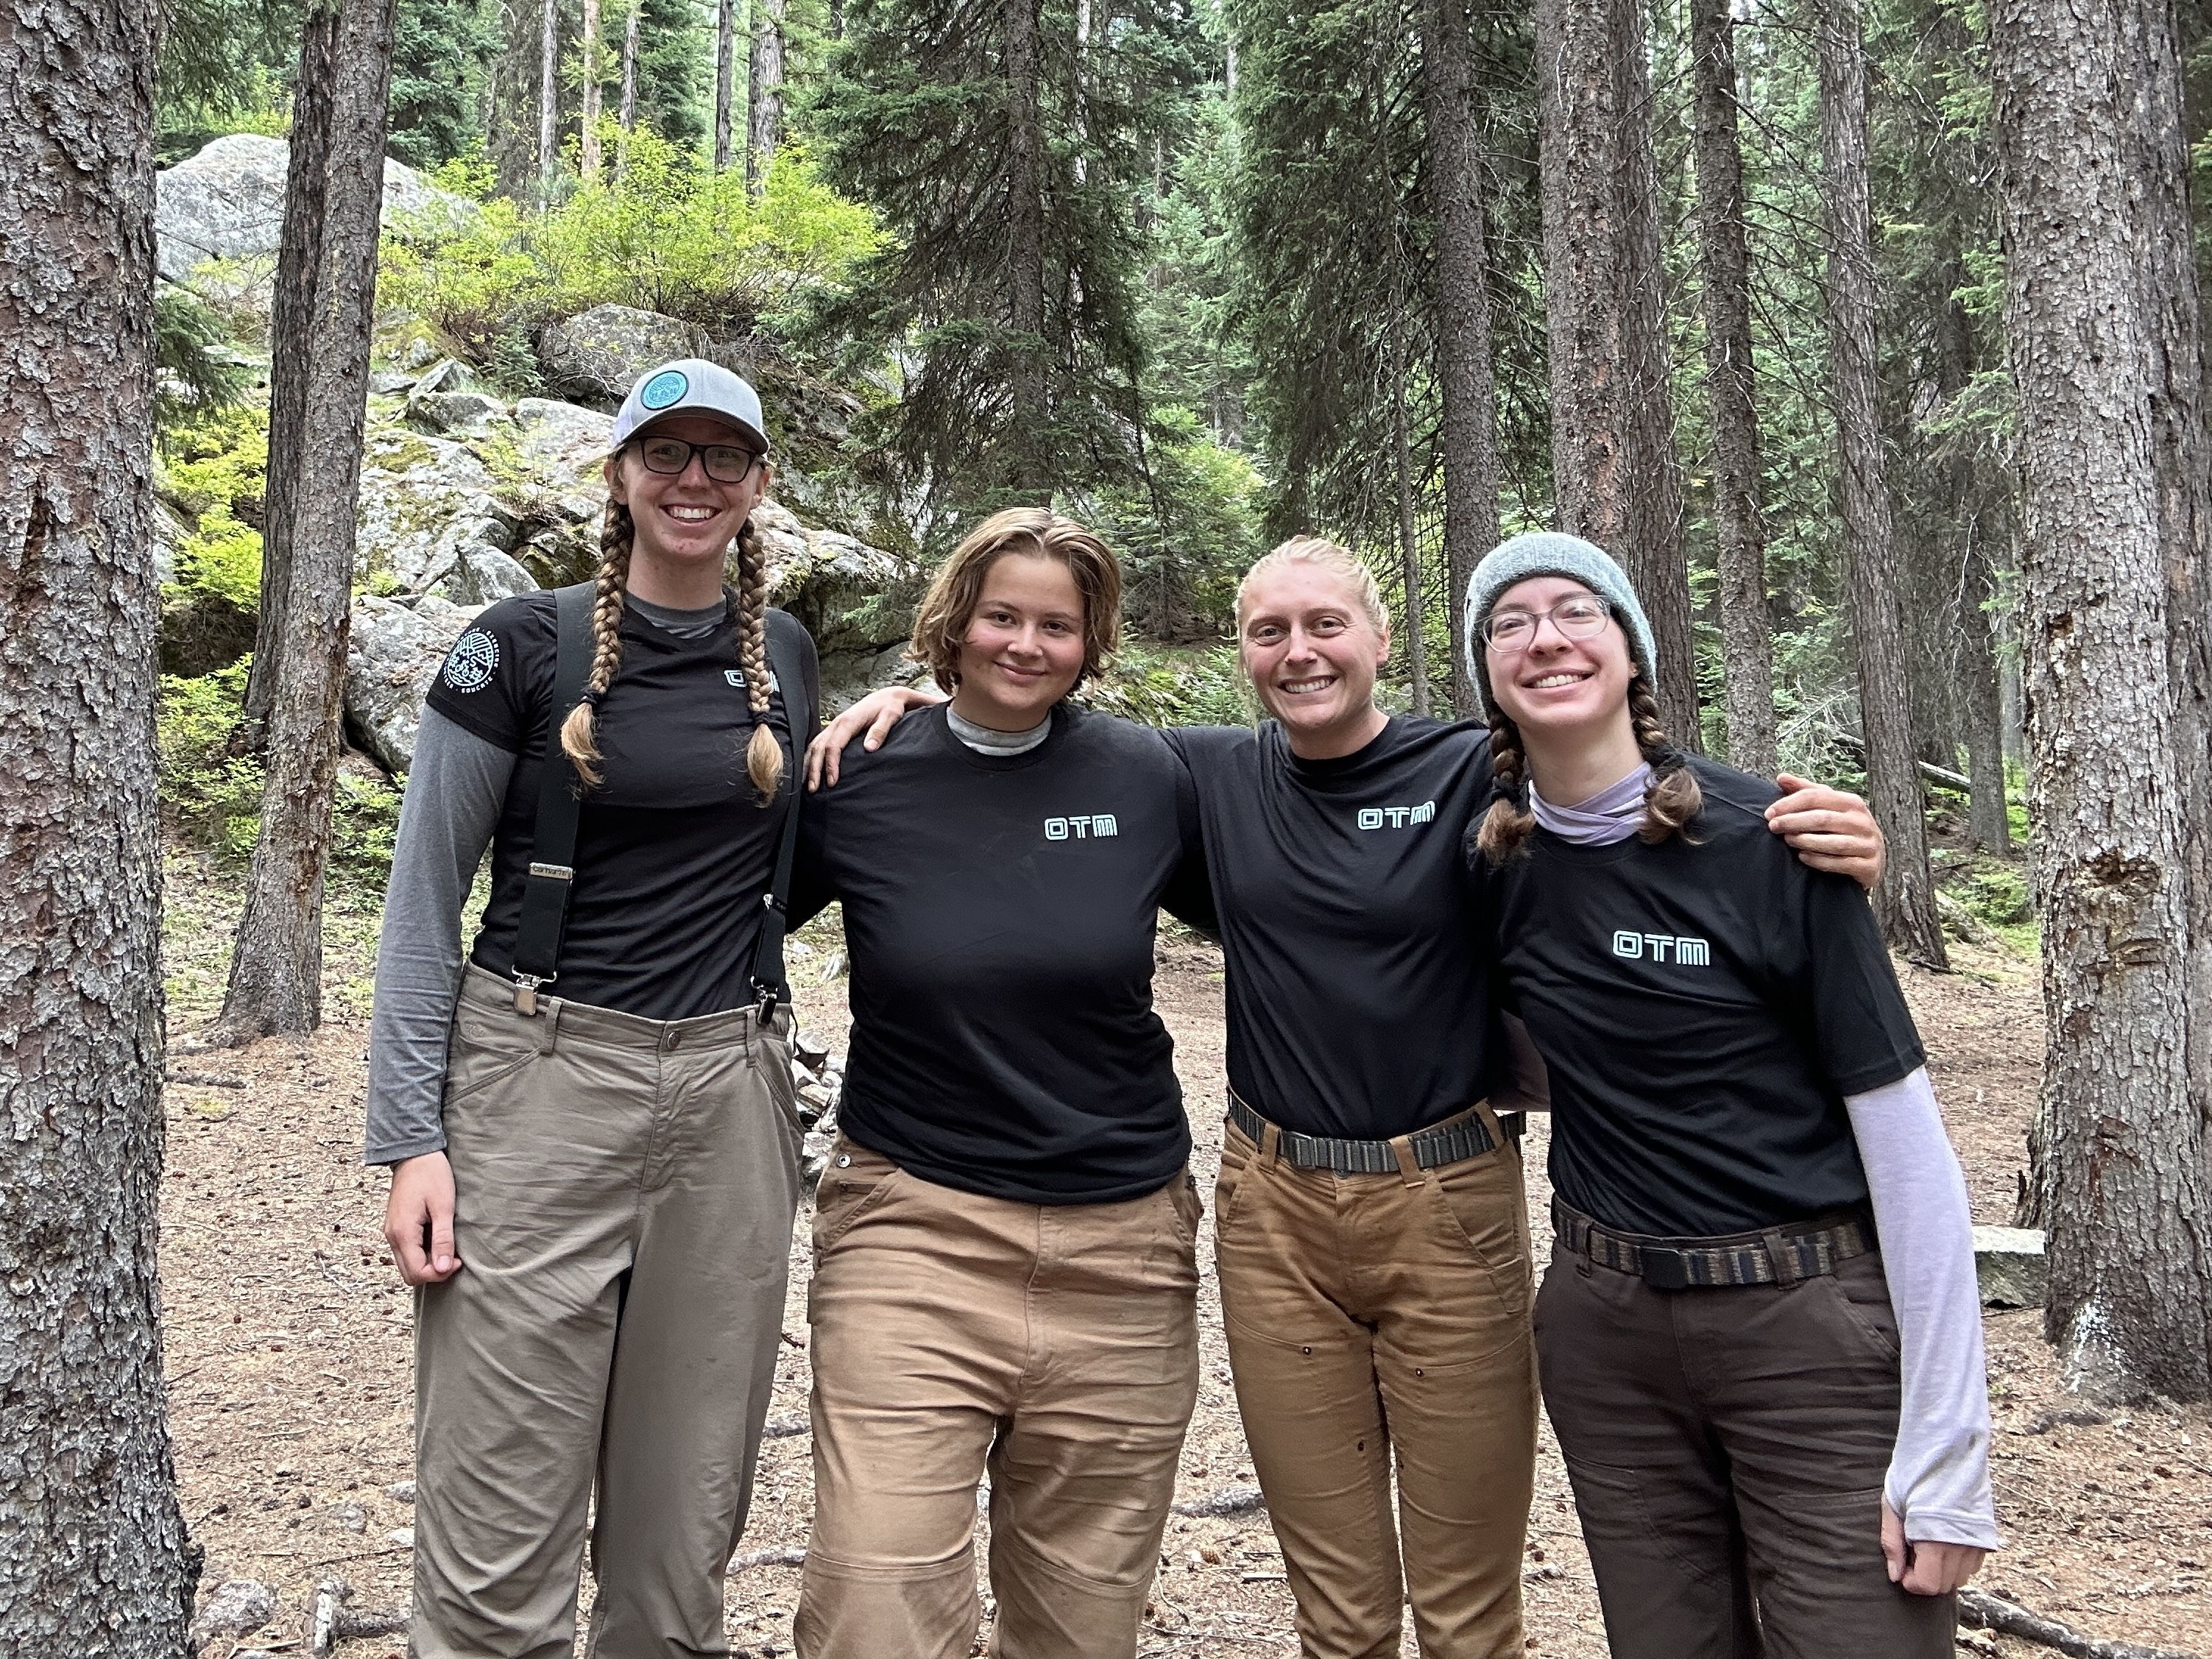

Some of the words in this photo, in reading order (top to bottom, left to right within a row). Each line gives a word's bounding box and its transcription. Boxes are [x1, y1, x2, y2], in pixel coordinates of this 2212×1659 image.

[1044, 813, 1118, 840] OTM
[1357, 800, 1435, 830] OTM
[1612, 930, 1710, 966] OTM
